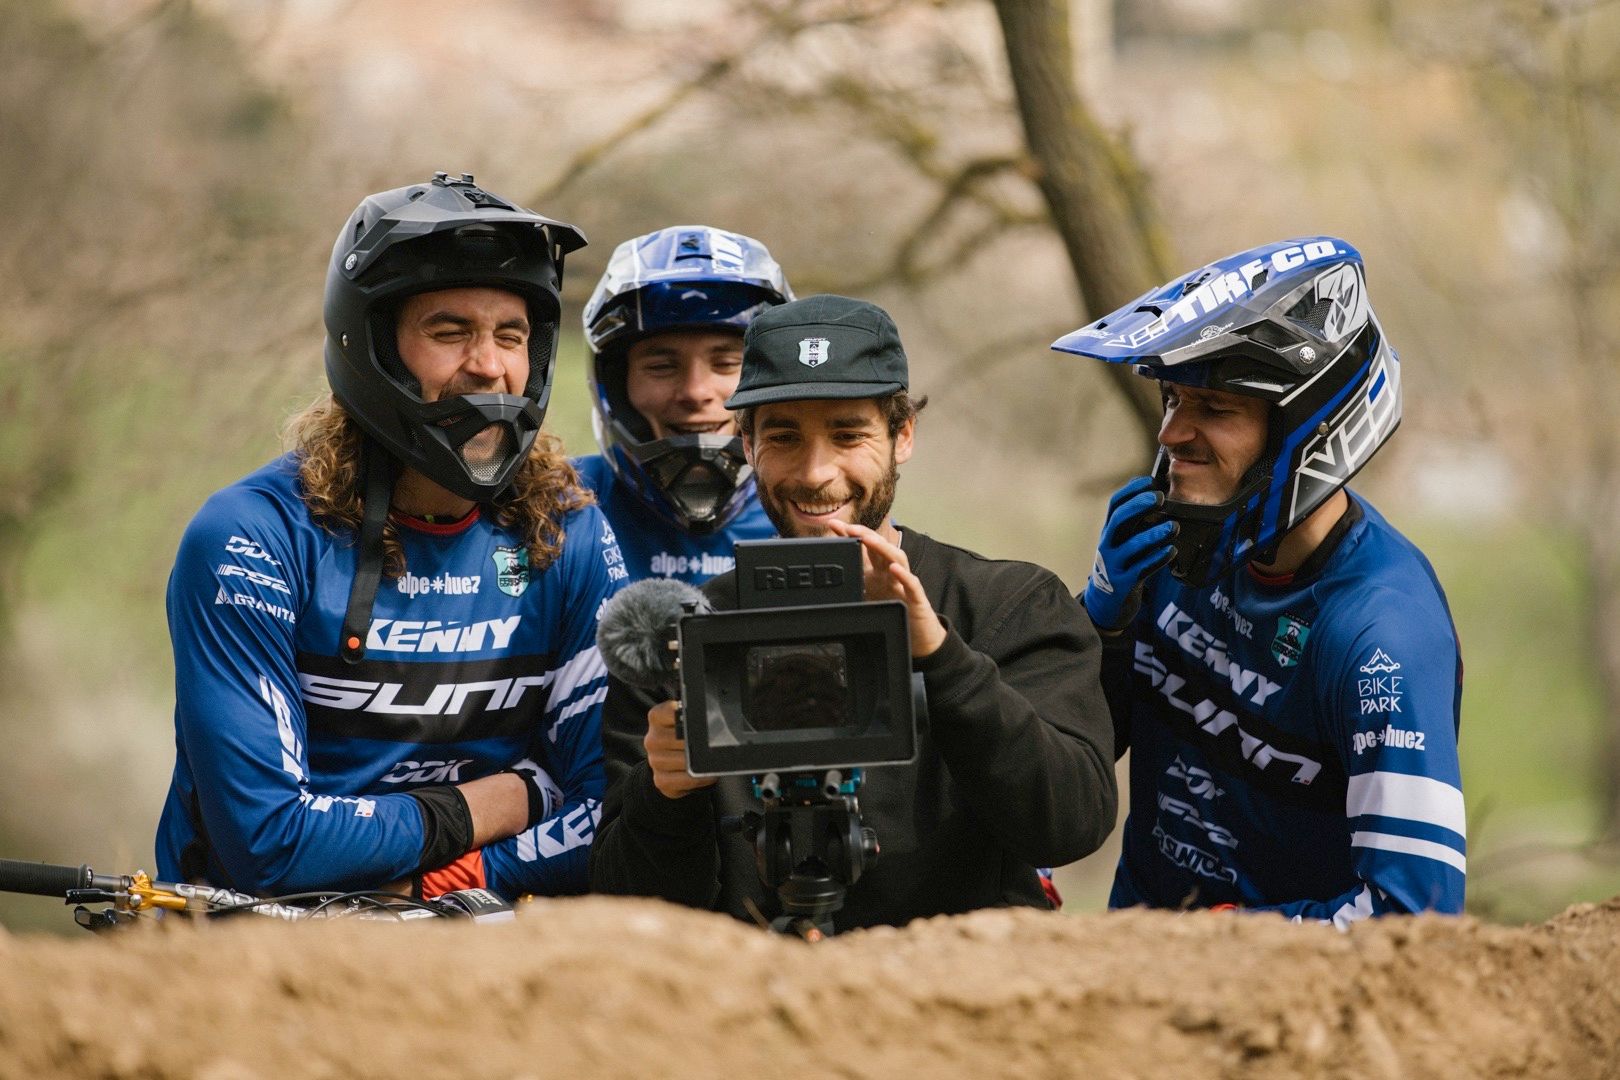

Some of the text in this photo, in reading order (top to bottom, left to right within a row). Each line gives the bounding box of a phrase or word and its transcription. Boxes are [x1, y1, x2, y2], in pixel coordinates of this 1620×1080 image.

[1271, 240, 1346, 273] CO.
[701, 552, 736, 576] hue
[754, 563, 845, 592] RED
[366, 615, 522, 653] KENNY
[1156, 601, 1283, 706] KENNY
[1358, 676, 1404, 697] BIKE
[1360, 696, 1402, 715] PARK
